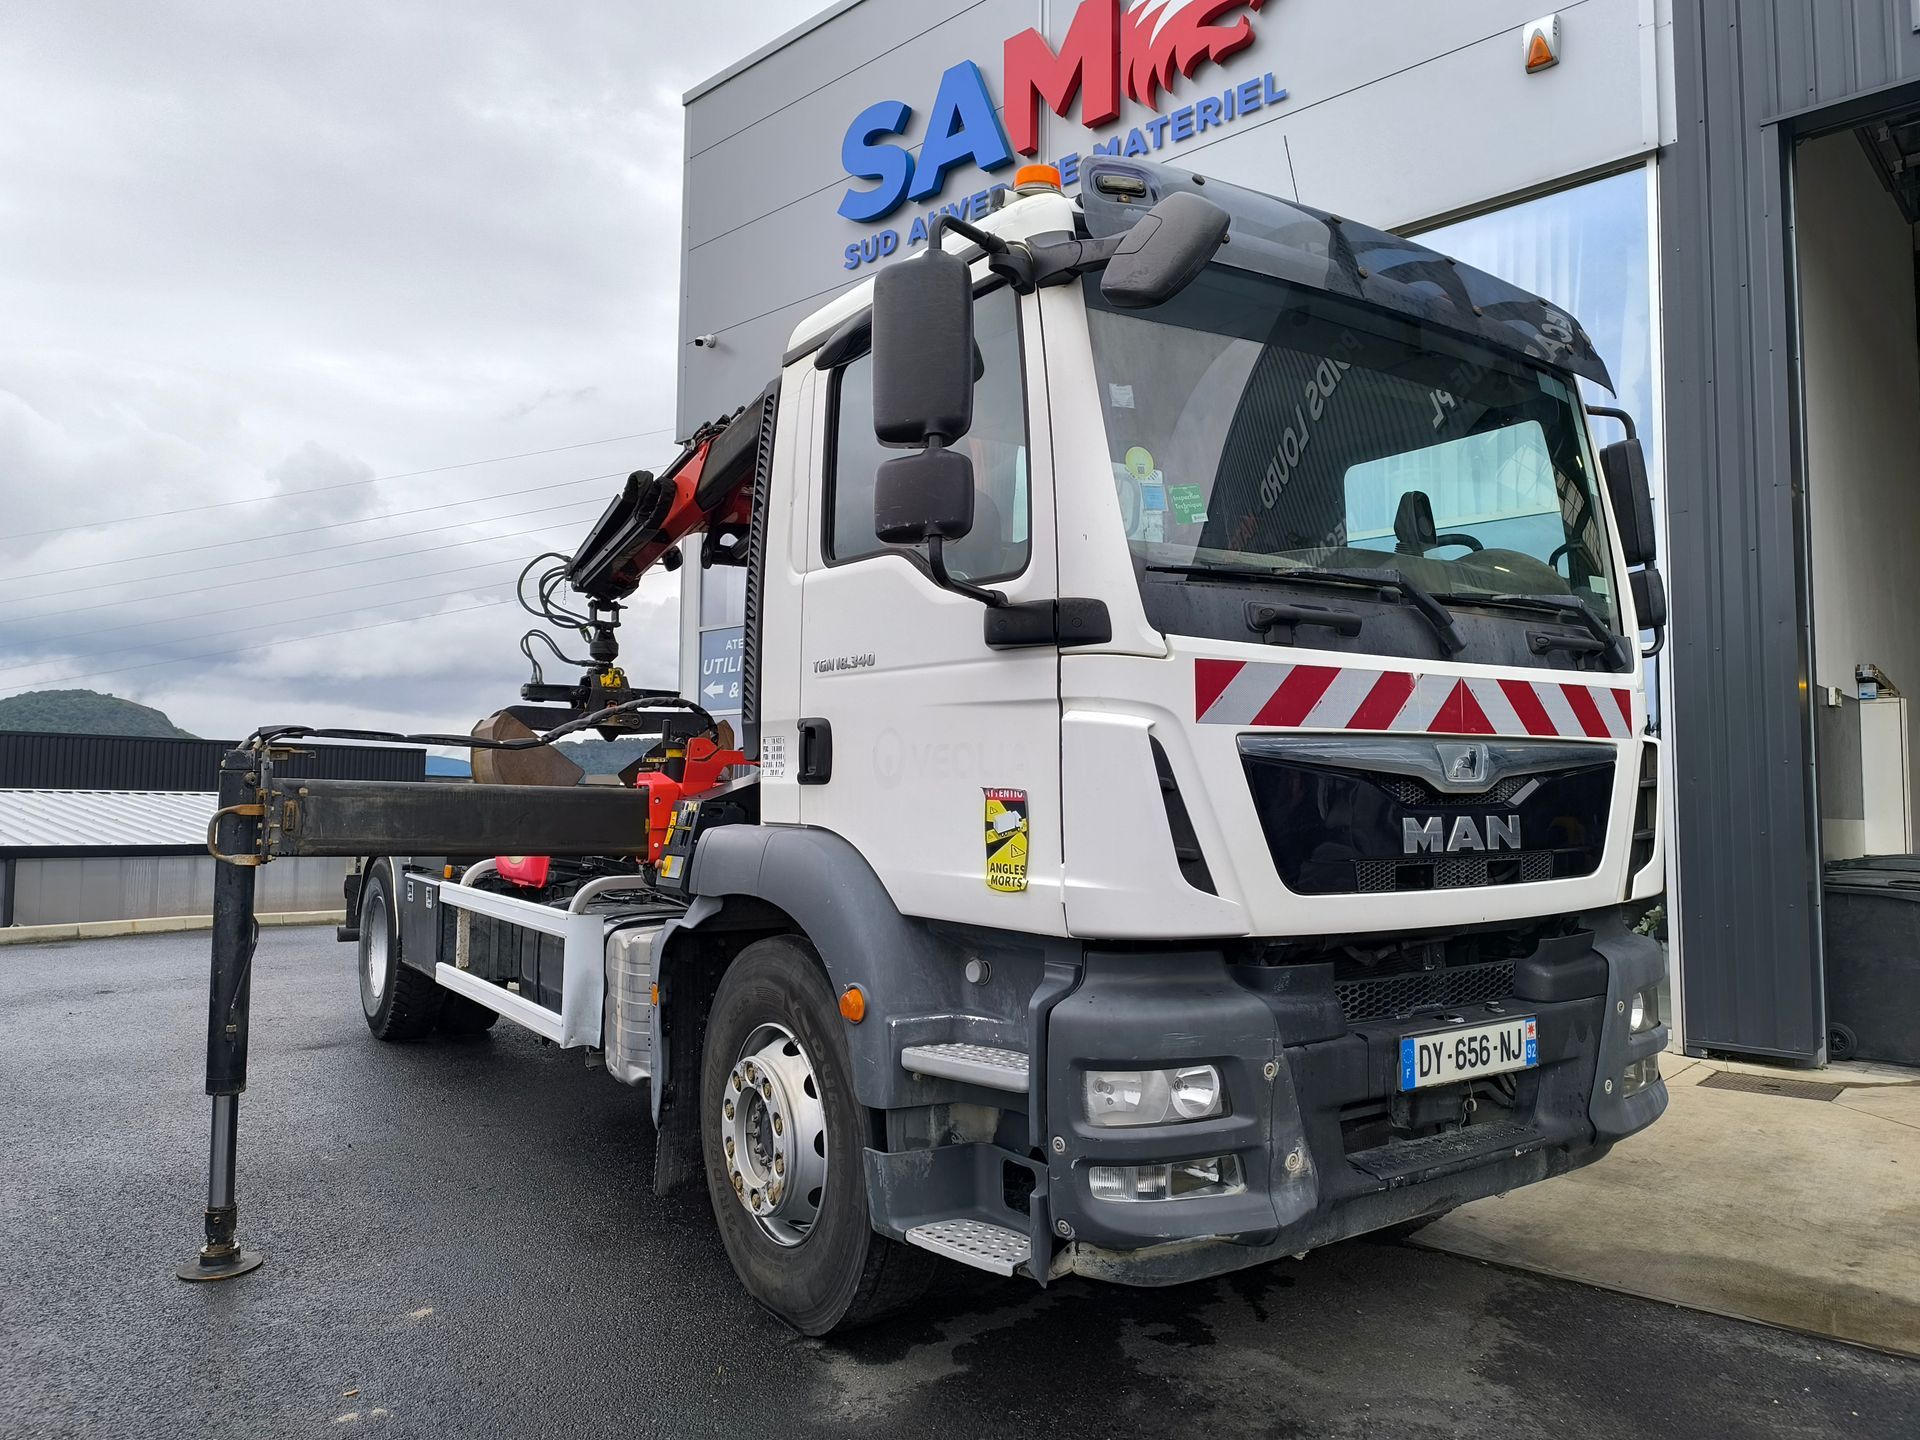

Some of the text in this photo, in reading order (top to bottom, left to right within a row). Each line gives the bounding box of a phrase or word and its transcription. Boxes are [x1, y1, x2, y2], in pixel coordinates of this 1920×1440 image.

[837, 0, 1120, 223] SAM
[843, 229, 898, 270] SUD
[725, 637, 744, 651] ATE
[703, 656, 743, 675] UTILI
[835, 652, 876, 670] 18.340
[728, 681, 740, 699] &
[1402, 814, 1521, 854] MAN
[990, 862, 1025, 876] ANGLES
[990, 874, 1023, 888] MORTS
[1419, 1028, 1537, 1078] DY-656-NJ 92
[1405, 1068, 1412, 1079] F
